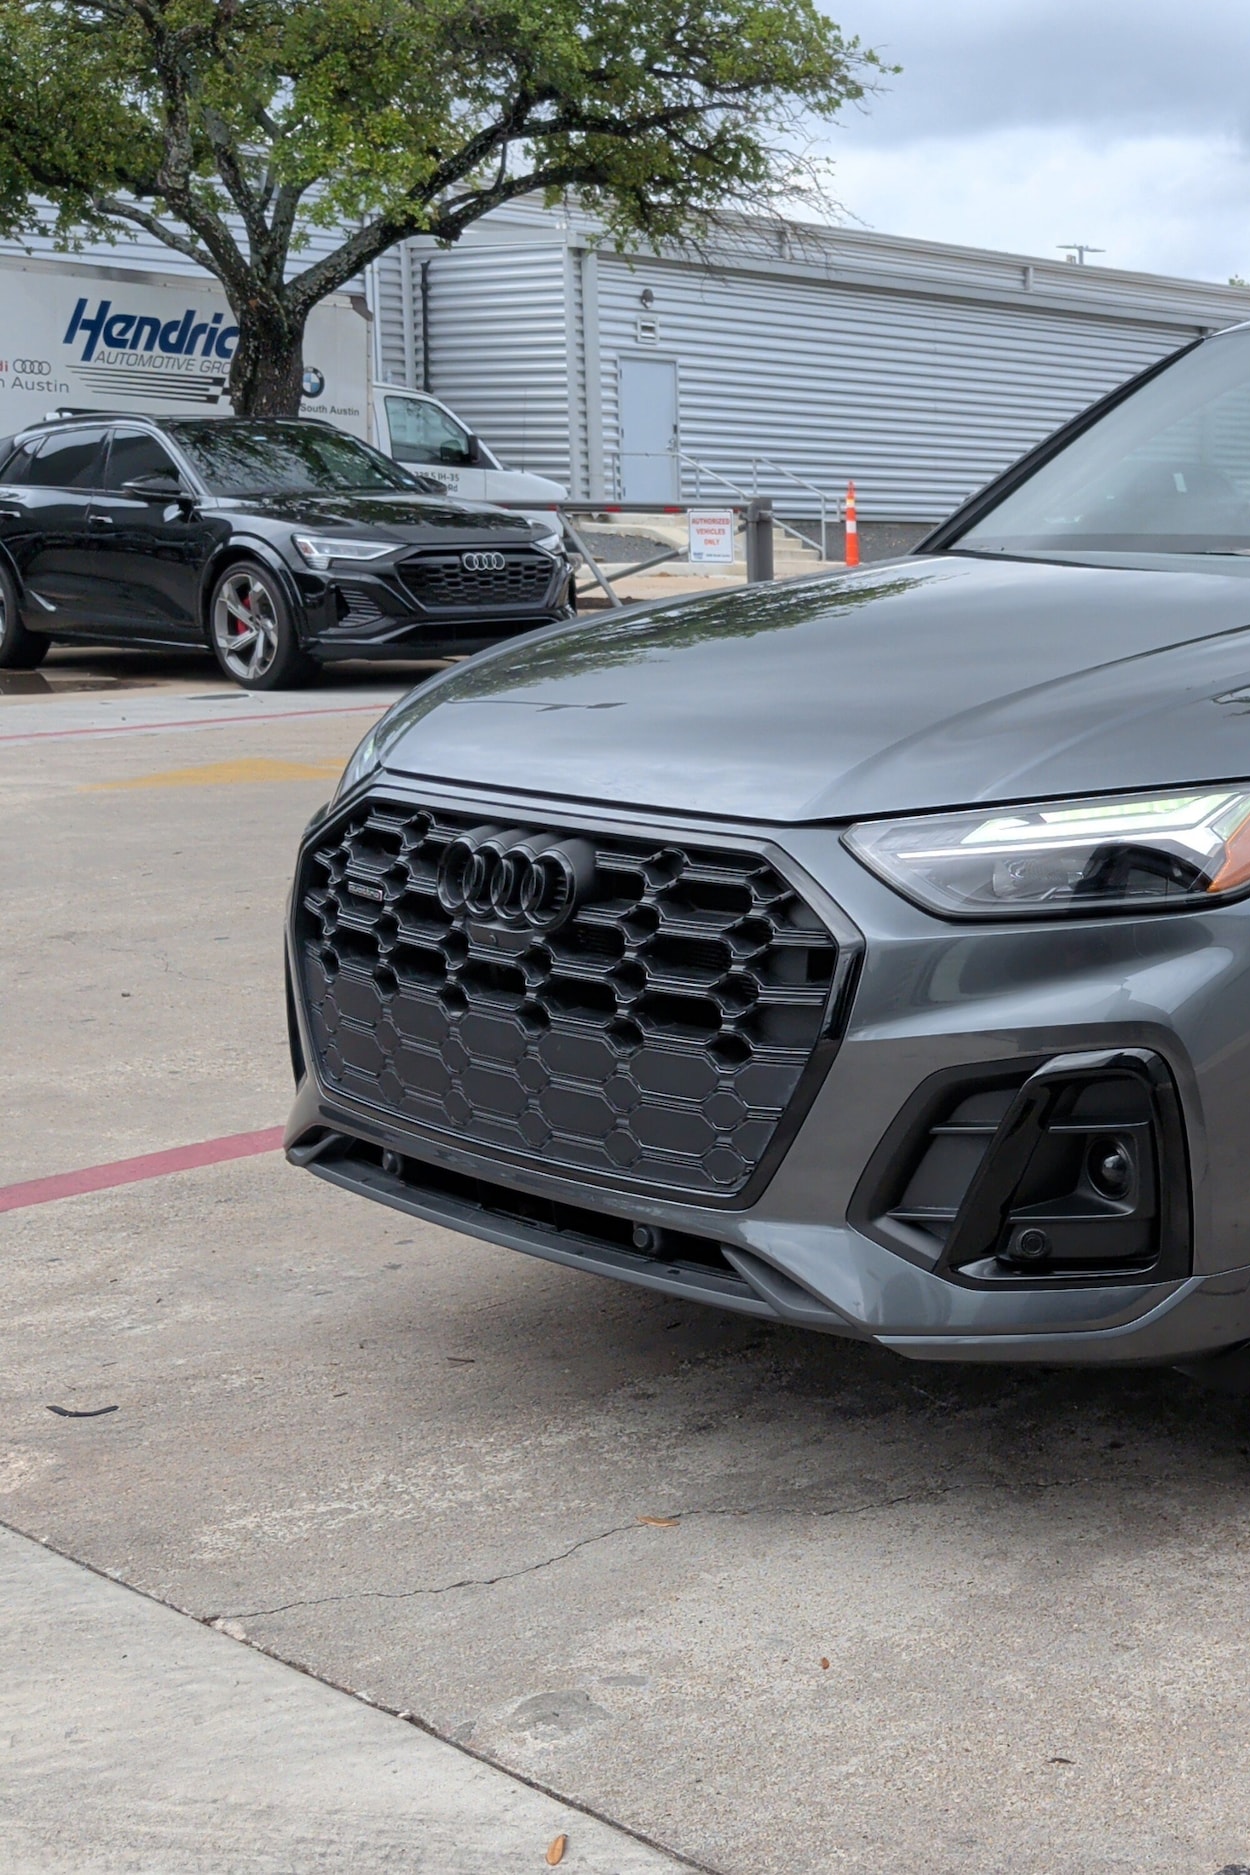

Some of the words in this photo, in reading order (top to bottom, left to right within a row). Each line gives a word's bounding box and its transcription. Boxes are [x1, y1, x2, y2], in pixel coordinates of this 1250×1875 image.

[95, 350, 197, 372] AUTOMOTIVE
[11, 376, 70, 393] Austin
[300, 402, 328, 414] South
[330, 405, 360, 416] Austin
[691, 517, 731, 526] AUTHORIZED
[696, 528, 726, 536] VEHICLES
[703, 538, 720, 546] ONLY
